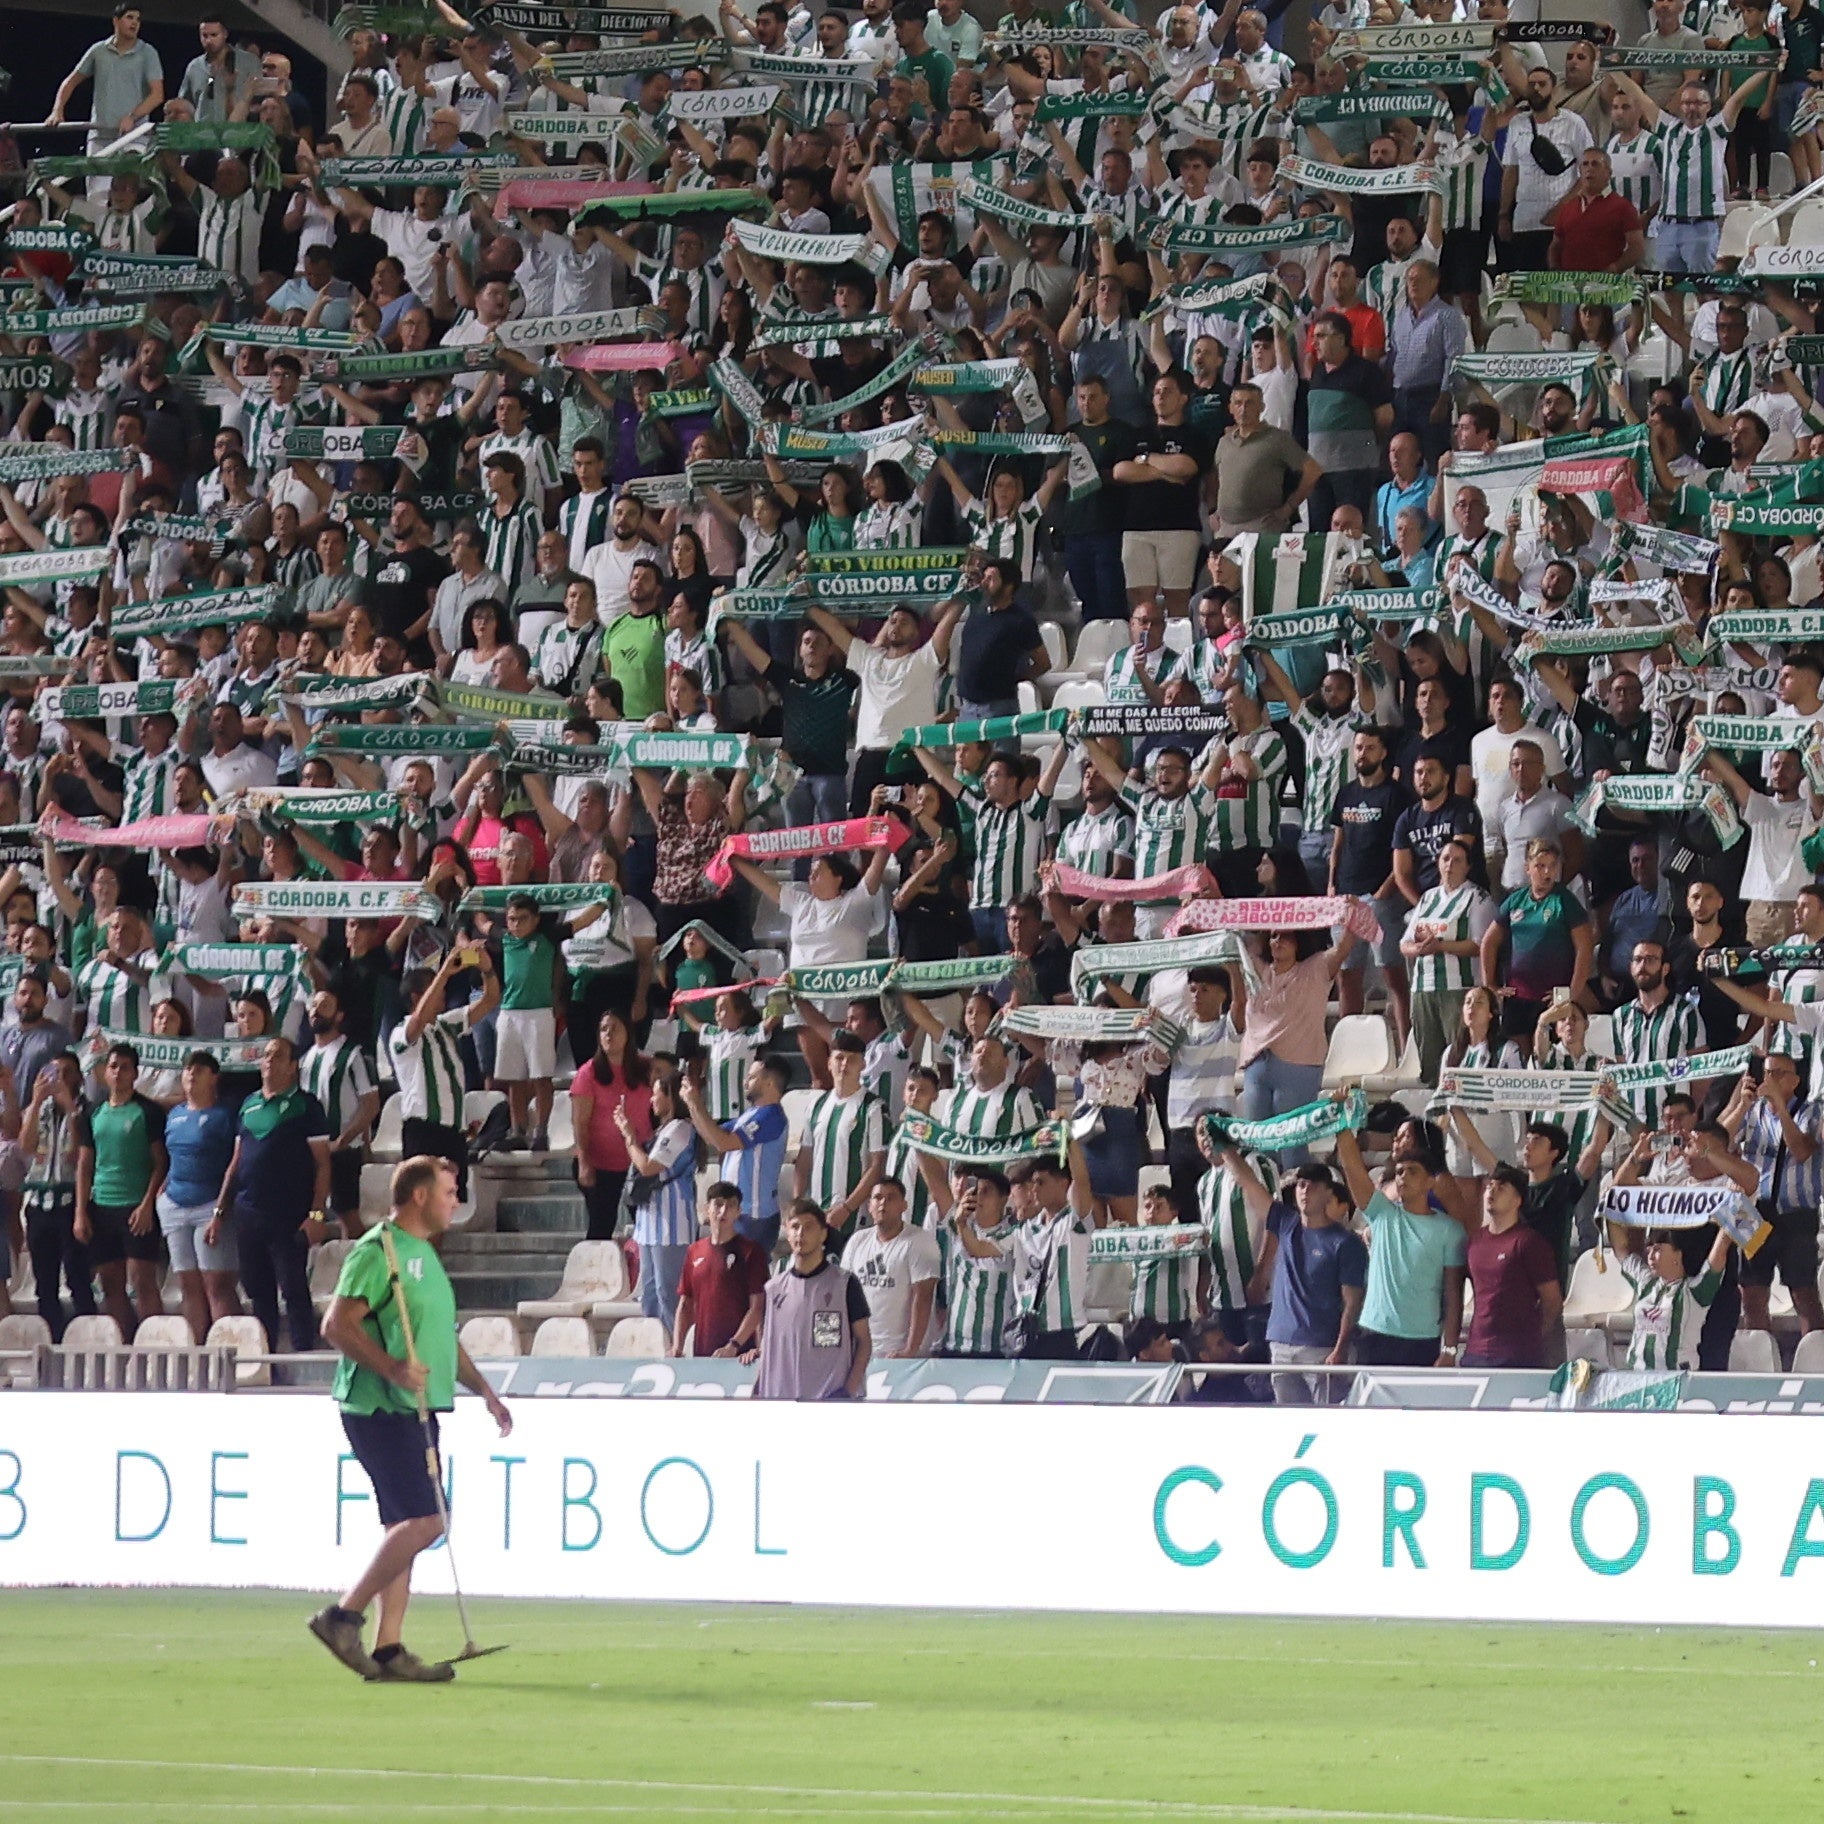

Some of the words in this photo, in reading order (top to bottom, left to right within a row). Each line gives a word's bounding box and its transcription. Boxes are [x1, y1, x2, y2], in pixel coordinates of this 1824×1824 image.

[539, 12, 559, 28] DEL
[1374, 31, 1476, 49] CÓRDOBA
[679, 93, 769, 114] CÓRDOBA
[817, 573, 920, 597] CÓRDOBA
[923, 571, 952, 592] CF
[1093, 709, 1104, 718] SI
[1106, 708, 1123, 718] ME
[1125, 708, 1148, 718] DAS
[1150, 707, 1158, 717] A
[1078, 720, 1086, 733] Y
[1088, 719, 1124, 734] AMOR,
[1127, 719, 1143, 733] ME
[1145, 718, 1183, 732] QUEDO
[1185, 716, 1229, 731] CONTIG
[268, 887, 354, 909] CÓRDOBA
[359, 888, 389, 908] C.F.
[1607, 1191, 1628, 1217] LO
[113, 1449, 250, 1546] DE
